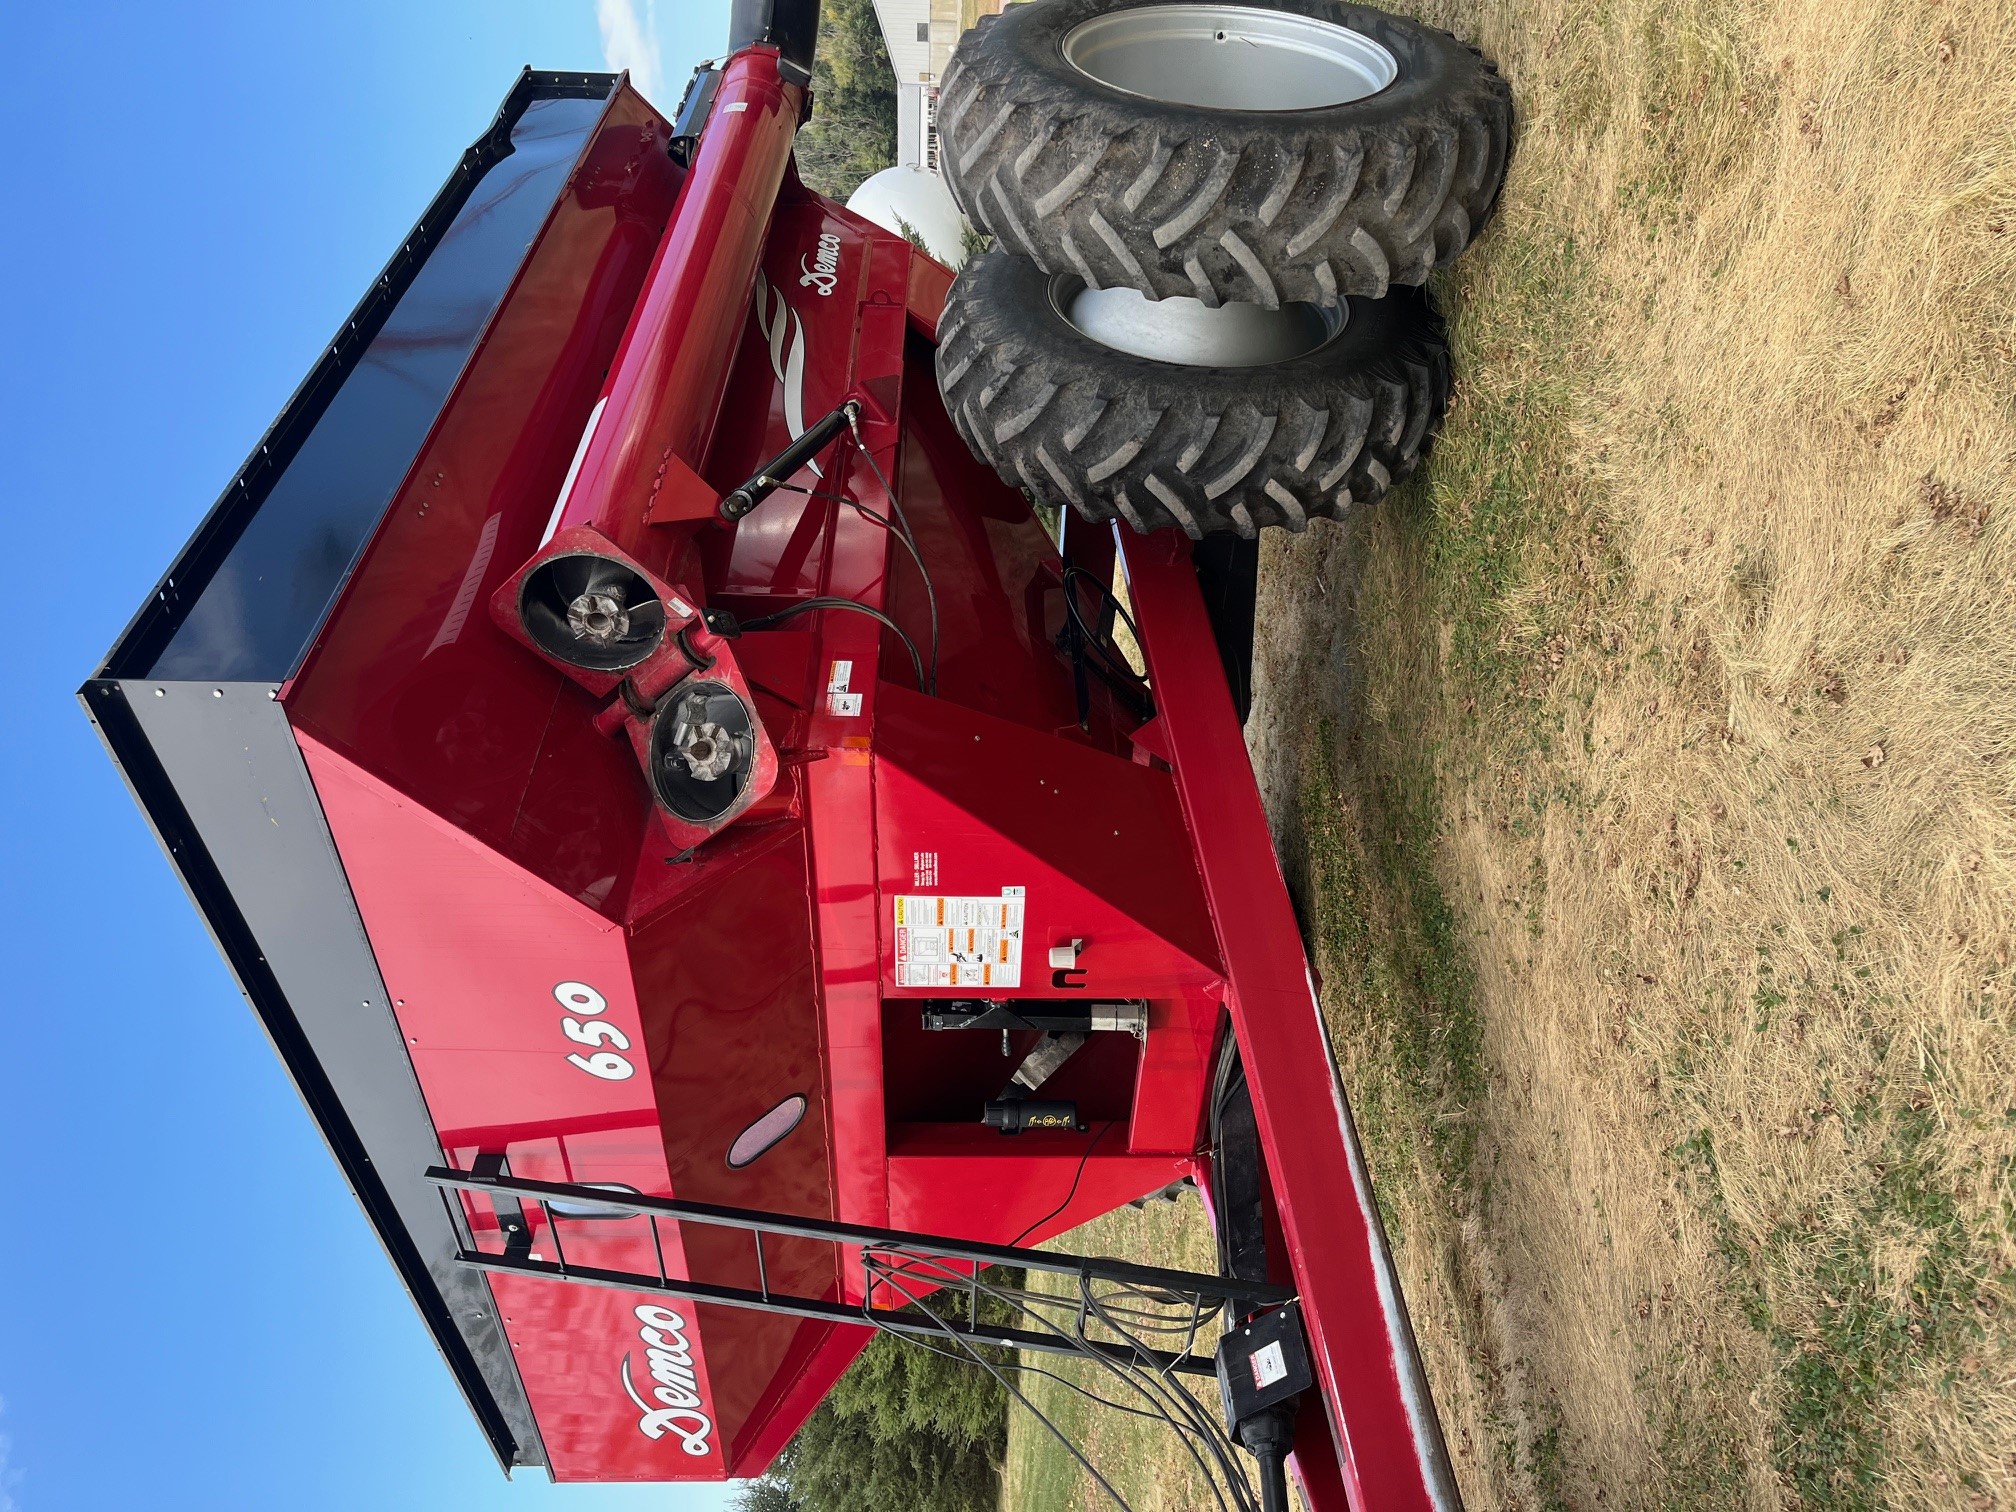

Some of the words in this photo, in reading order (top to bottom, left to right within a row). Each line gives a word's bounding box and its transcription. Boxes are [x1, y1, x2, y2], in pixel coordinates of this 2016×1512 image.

[799, 233, 841, 296] Demco
[551, 980, 636, 1081] 650
[621, 1303, 712, 1457] Demco
[1249, 1354, 1260, 1380] DANGER
